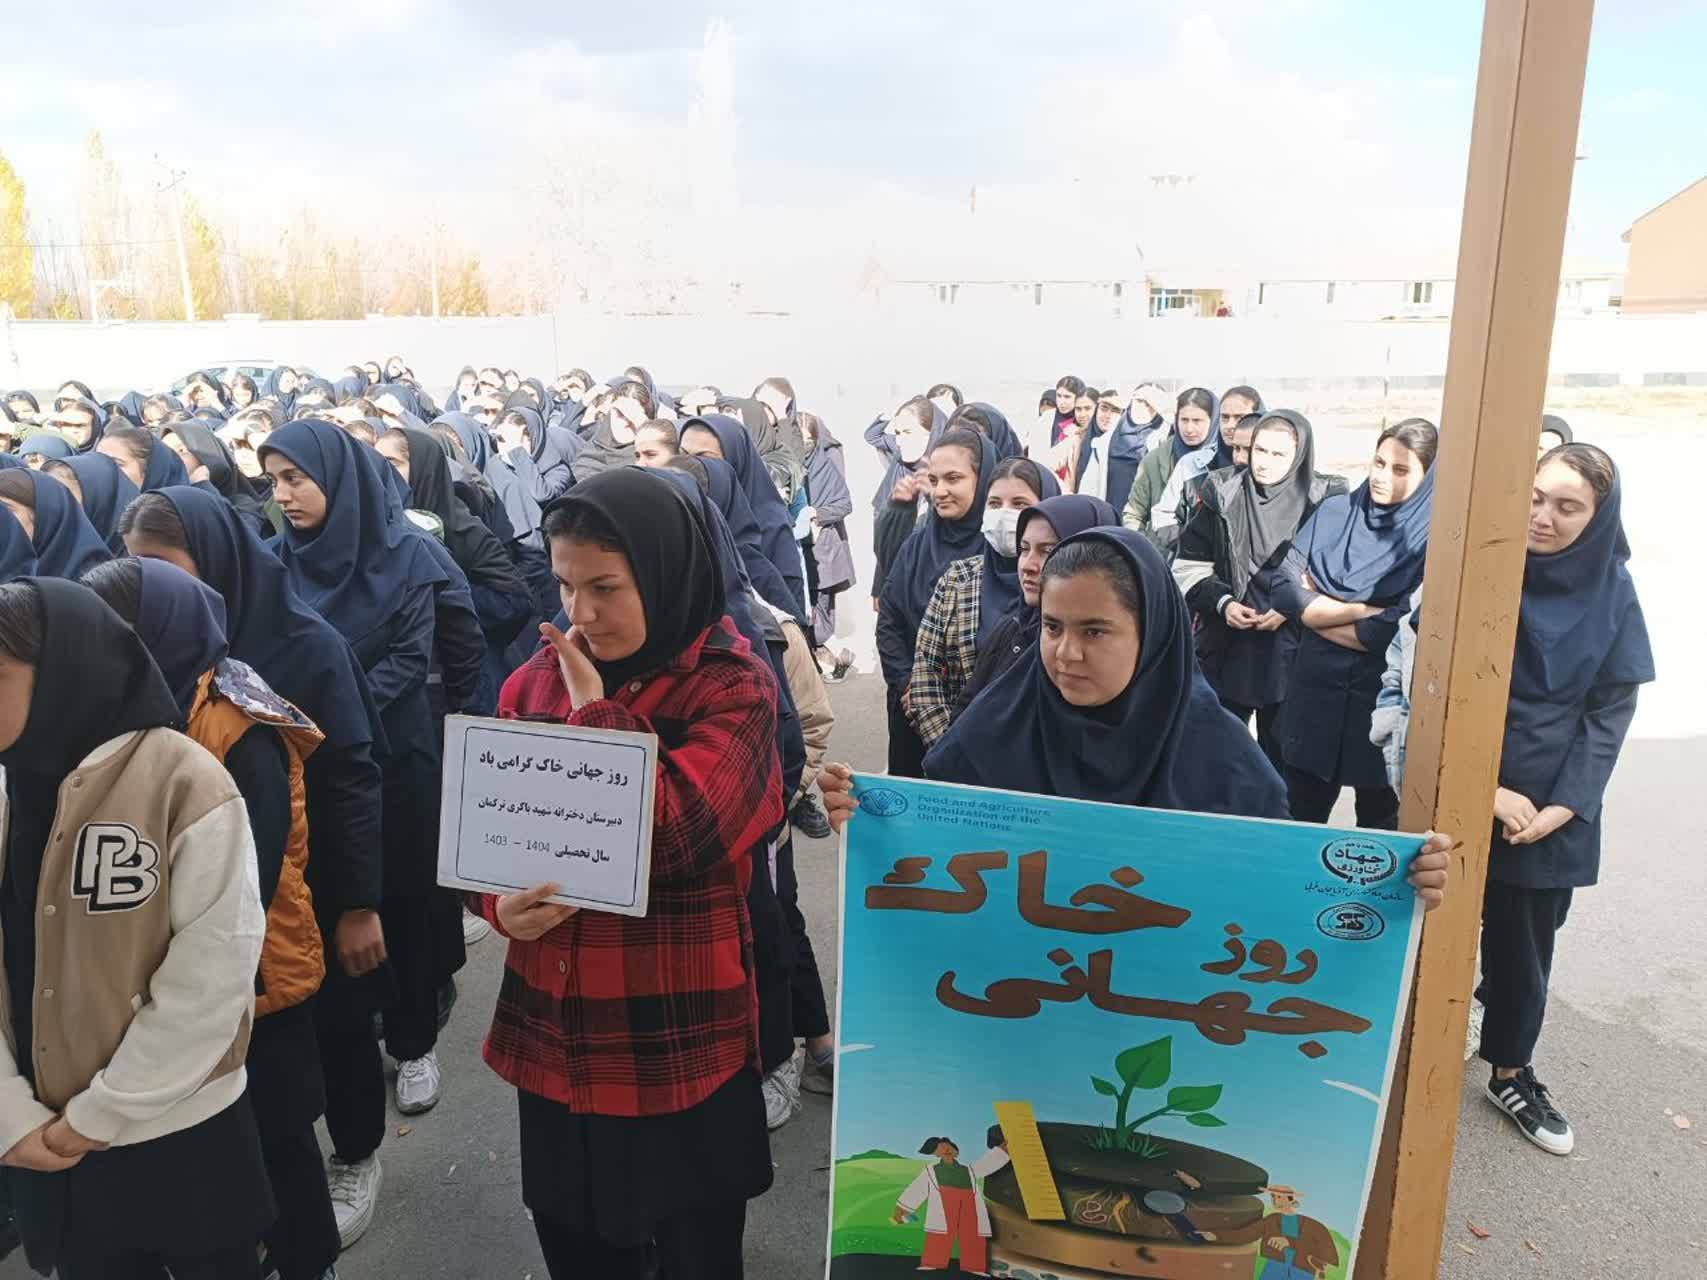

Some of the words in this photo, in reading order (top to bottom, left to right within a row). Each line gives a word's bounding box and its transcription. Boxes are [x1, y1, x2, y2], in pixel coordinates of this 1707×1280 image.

[479, 750, 495, 766] باد
[496, 754, 533, 773] گرامی
[535, 757, 564, 773] خاک
[567, 761, 604, 783] جهانی
[607, 769, 629, 786] روز
[506, 801, 531, 815] باکری
[951, 798, 976, 809] and
[553, 806, 585, 821] دخترانه
[585, 808, 623, 828] دبیرستان
[917, 804, 999, 822] Organization
[1000, 812, 1017, 823] of
[1020, 814, 1041, 825] the
[917, 813, 959, 825] United
[962, 818, 1013, 831] Nations
[484, 833, 508, 847] 1403
[526, 839, 551, 853] 1404
[554, 844, 590, 859] تحصیلی
[591, 846, 611, 863] سال
[1334, 848, 1385, 865] جهاد
[1200, 923, 1319, 985] روز
[936, 949, 1373, 1060] جهانی
